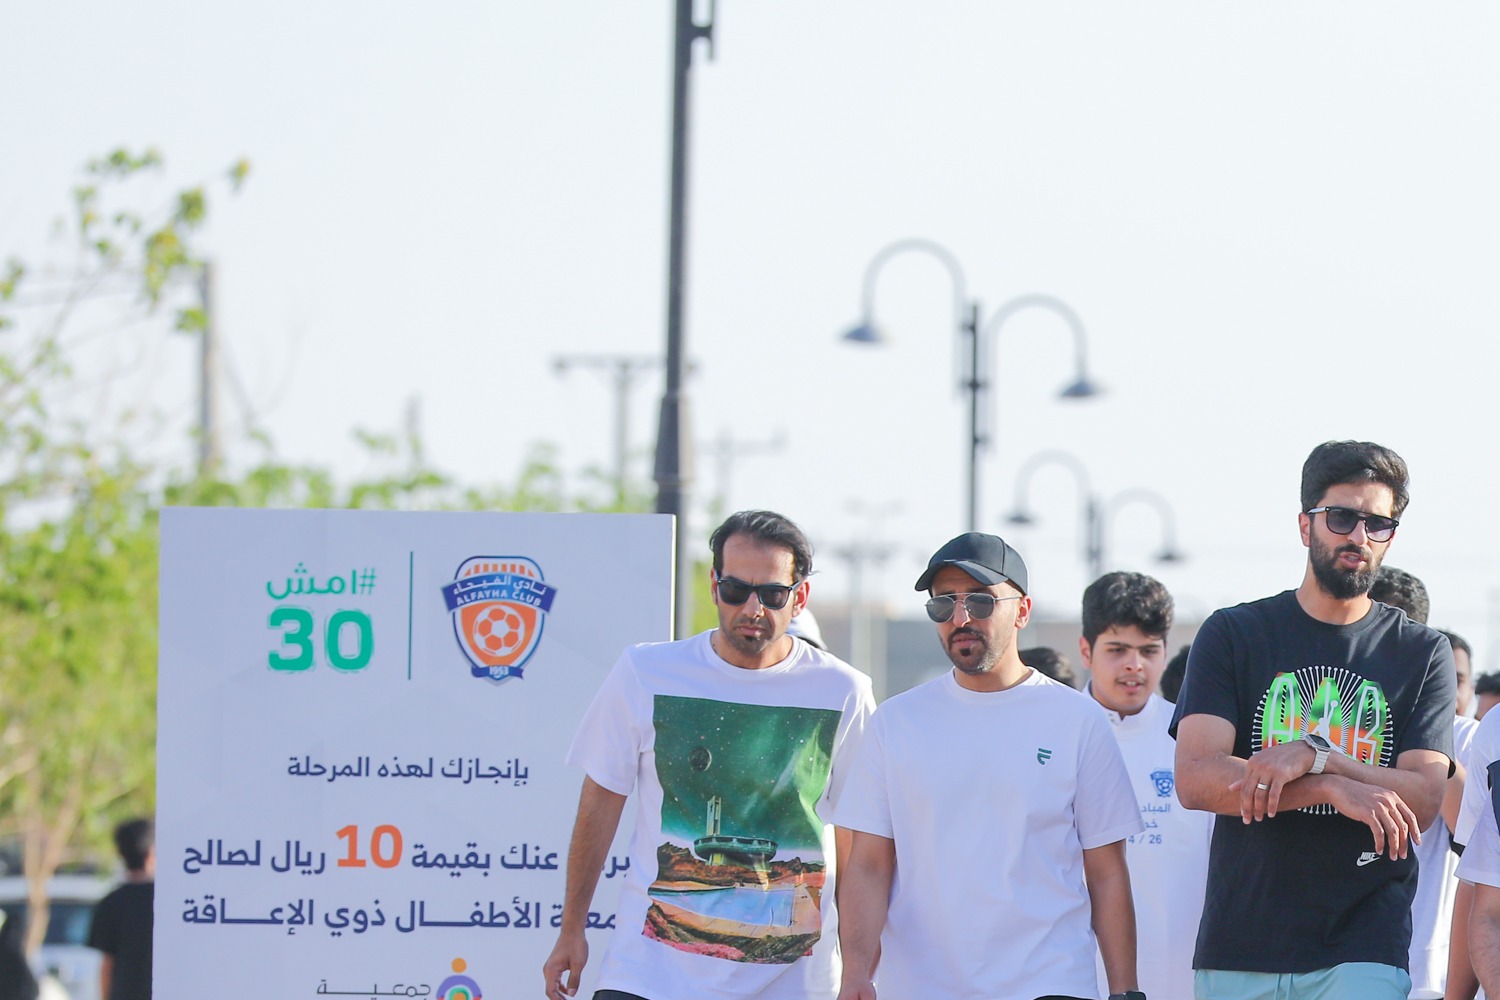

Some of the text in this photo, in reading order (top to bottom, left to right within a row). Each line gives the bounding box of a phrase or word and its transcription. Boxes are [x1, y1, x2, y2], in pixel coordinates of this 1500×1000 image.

[453, 574, 548, 596] نادي الفيحاء
[456, 589, 542, 607] ALFAYHA CLUB
[267, 605, 376, 673] 30
[287, 755, 529, 787] بإنجازك لهذه المرحلة
[1141, 803, 1171, 815] المباد
[182, 838, 261, 875] لصالح
[270, 840, 326, 876] ريال
[335, 824, 404, 869] 10
[411, 842, 491, 878] بقيمة
[500, 843, 559, 871] عنك
[1360, 851, 1377, 861] NIKE
[182, 894, 314, 936] الإعاقة
[324, 900, 387, 937] ذوي
[395, 897, 541, 934] الأطفال
[316, 979, 431, 1000] جمعية
